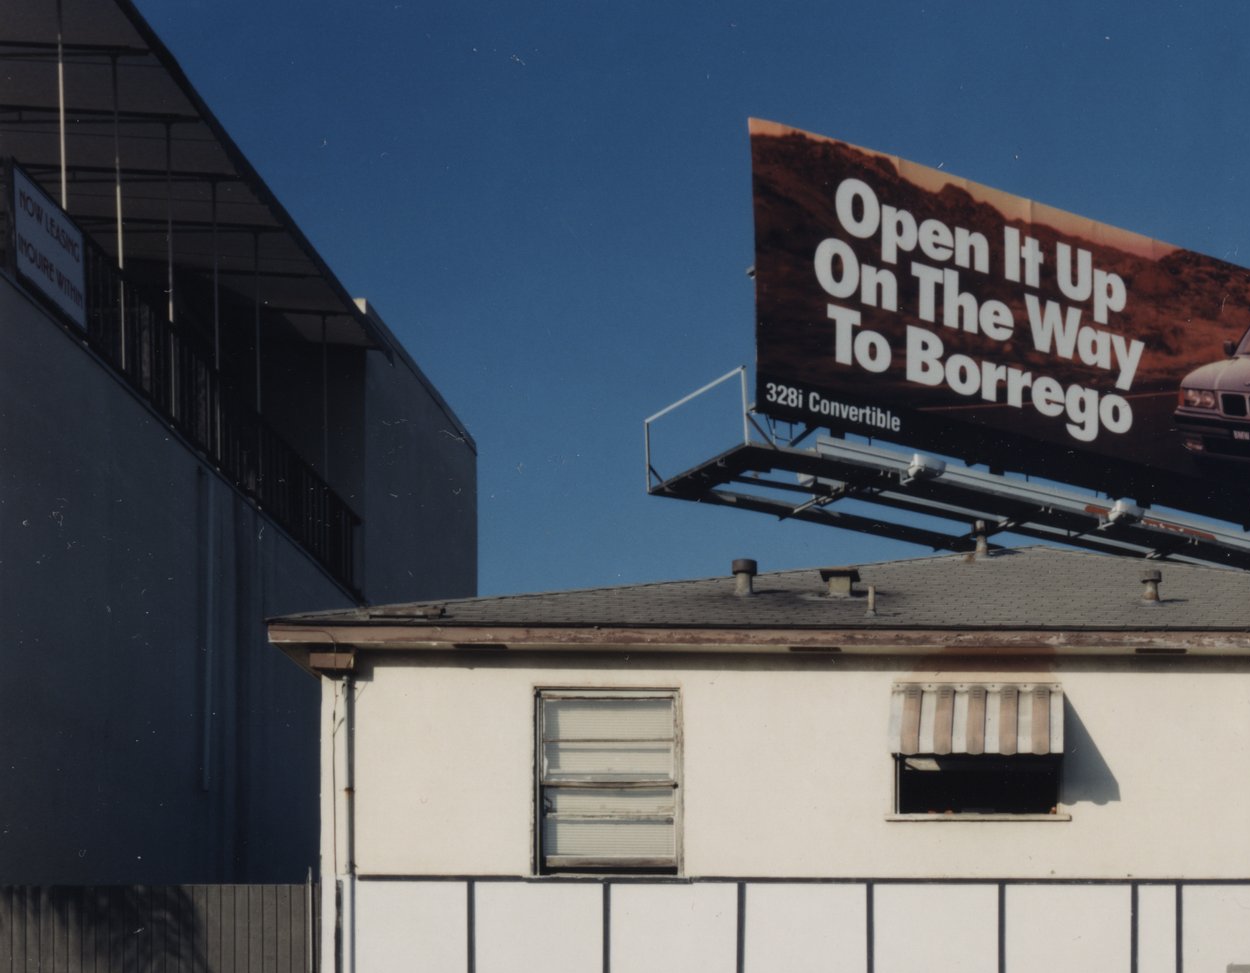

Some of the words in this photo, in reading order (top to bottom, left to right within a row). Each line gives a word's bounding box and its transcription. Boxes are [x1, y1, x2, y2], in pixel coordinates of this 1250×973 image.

[19, 187, 43, 226] NOW
[45, 212, 80, 264] LEASING
[835, 178, 989, 274] Open
[1004, 226, 1044, 289] It
[1056, 241, 1127, 325] Up
[56, 268, 84, 310] WITHIN
[814, 238, 898, 312] On
[911, 261, 1014, 341] The
[1024, 293, 1145, 391] Way
[766, 382, 803, 408] 328i
[809, 392, 901, 432] Convertible
[827, 303, 892, 373] To
[906, 325, 1133, 442] Borrego
